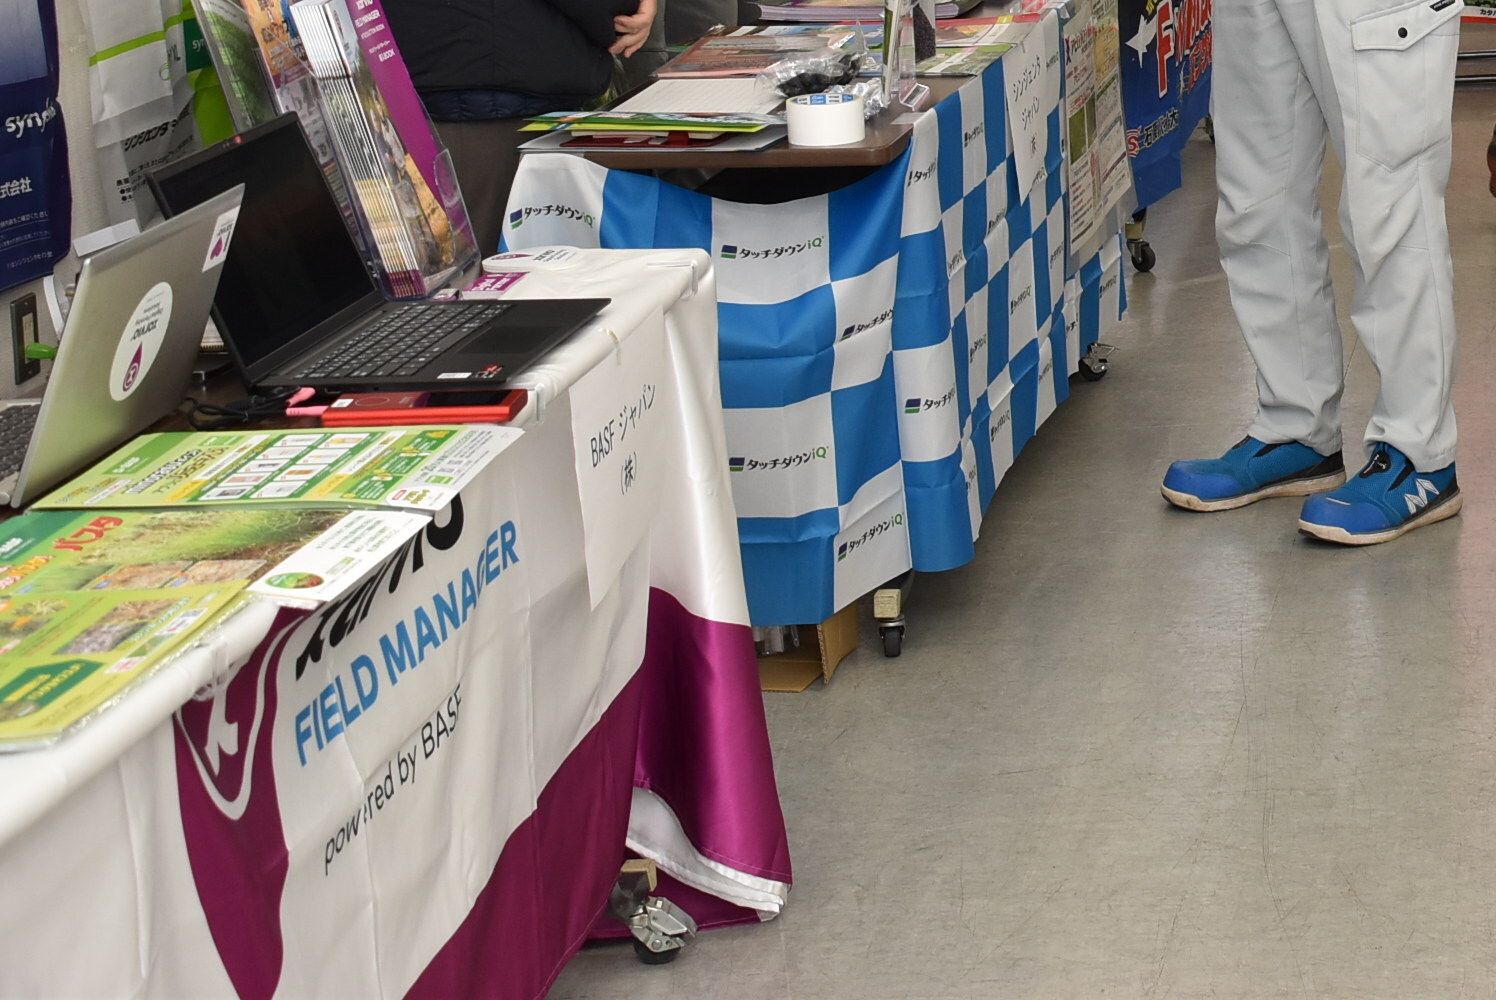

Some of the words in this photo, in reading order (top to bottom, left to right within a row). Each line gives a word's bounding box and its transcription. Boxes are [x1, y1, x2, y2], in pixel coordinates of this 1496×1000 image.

[739, 236, 824, 259] タッチダウンiQ
[590, 419, 615, 469] BASF
[618, 383, 656, 442] ジャパン
[747, 445, 828, 471] タッチダウンiQ
[848, 512, 904, 554] タッチダウンiQ
[295, 652, 380, 766] FIELD
[381, 519, 520, 684] MANAGER
[323, 773, 396, 876] powered
[398, 748, 417, 787] by
